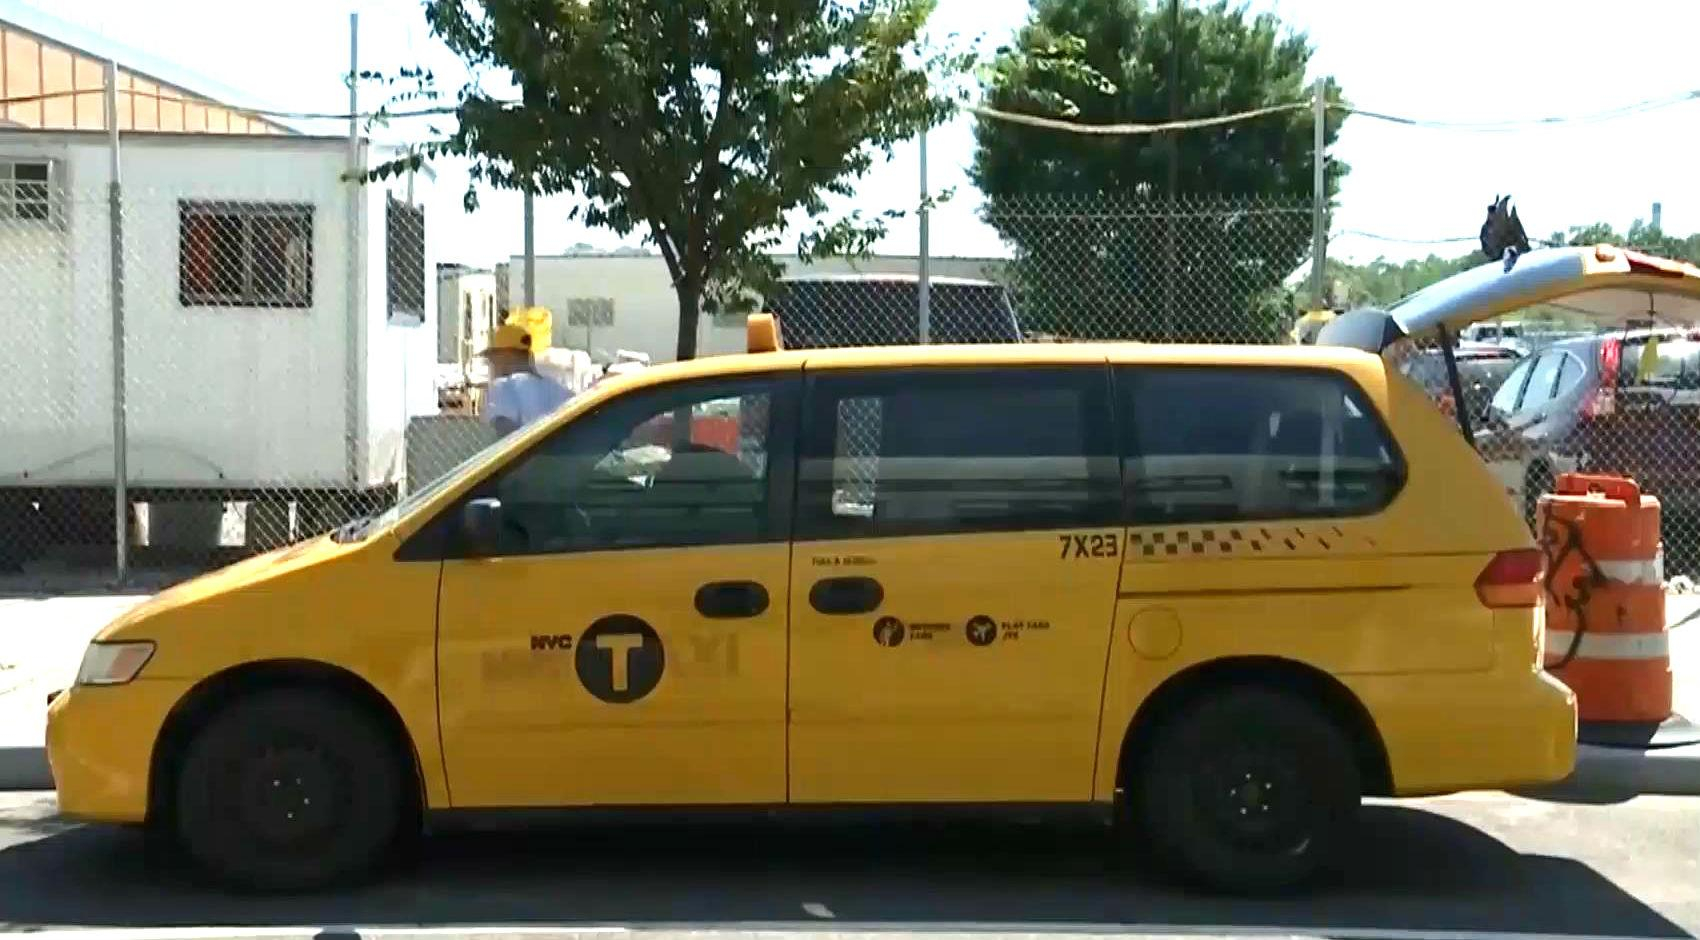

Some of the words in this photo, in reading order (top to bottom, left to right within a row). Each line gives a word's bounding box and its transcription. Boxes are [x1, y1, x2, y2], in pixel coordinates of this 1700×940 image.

[1060, 534, 1117, 559] 7X23
[531, 634, 572, 650] NYC
[597, 634, 643, 691] T
